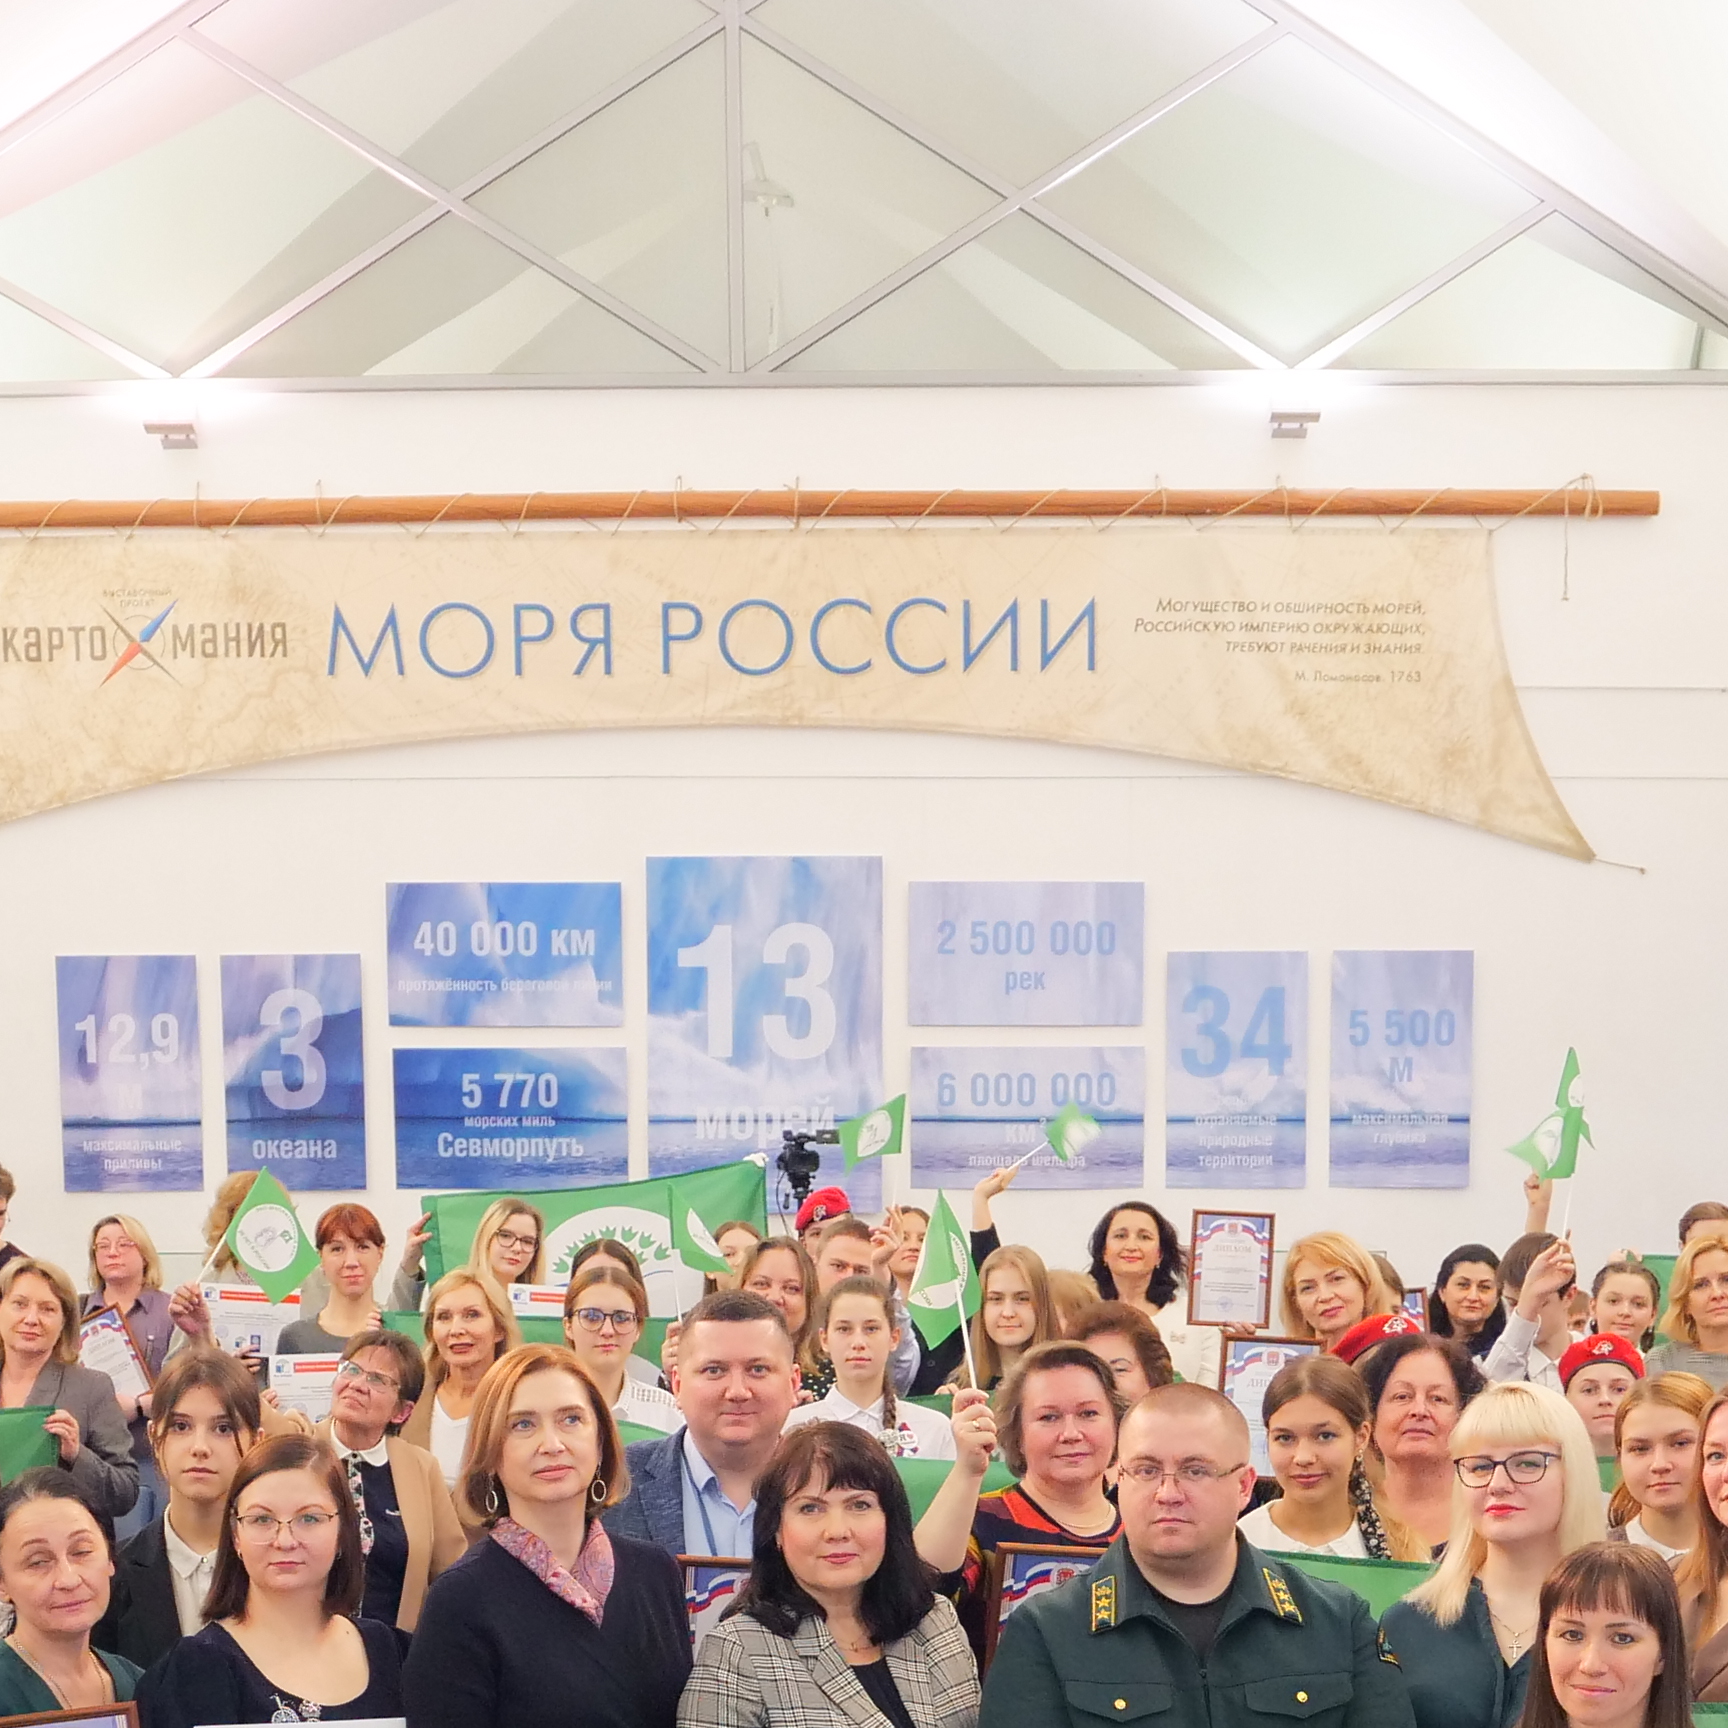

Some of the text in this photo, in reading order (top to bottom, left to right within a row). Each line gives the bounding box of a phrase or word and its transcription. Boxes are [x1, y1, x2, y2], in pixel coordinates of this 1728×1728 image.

[1261, 601, 1270, 613] И
[327, 597, 1097, 678] МОРЯ РОССИИ
[1239, 621, 1309, 634] ИМПЕРИЮ
[1225, 641, 1286, 654] ТРЕБУЮТ
[1290, 642, 1347, 654] РАЧЕНИЯ
[1350, 642, 1360, 654] И
[1390, 670, 1422, 683] 1763
[413, 921, 595, 957] 40 000 км
[936, 919, 1116, 956] 2 500 000
[677, 921, 837, 1060] 13
[1004, 968, 1046, 995] рек
[1180, 985, 1293, 1078] 34
[1348, 1008, 1456, 1048] 5 500
[74, 1014, 179, 1070] 12,9
[260, 988, 327, 1110] 3
[462, 1073, 558, 1108] 5 770
[936, 1072, 1116, 1107] 6 000 000
[464, 1116, 555, 1130] морских миль
[1195, 1115, 1278, 1128] охраняемые
[1352, 1113, 1448, 1127] максимальная
[83, 1139, 182, 1152] максимальные
[252, 1138, 338, 1159] океана
[437, 1132, 584, 1162] Севморпуть
[1199, 1135, 1273, 1149] природные
[1373, 1131, 1426, 1145] глубина
[104, 1158, 162, 1173] приливы
[1198, 1155, 1273, 1169] территории
